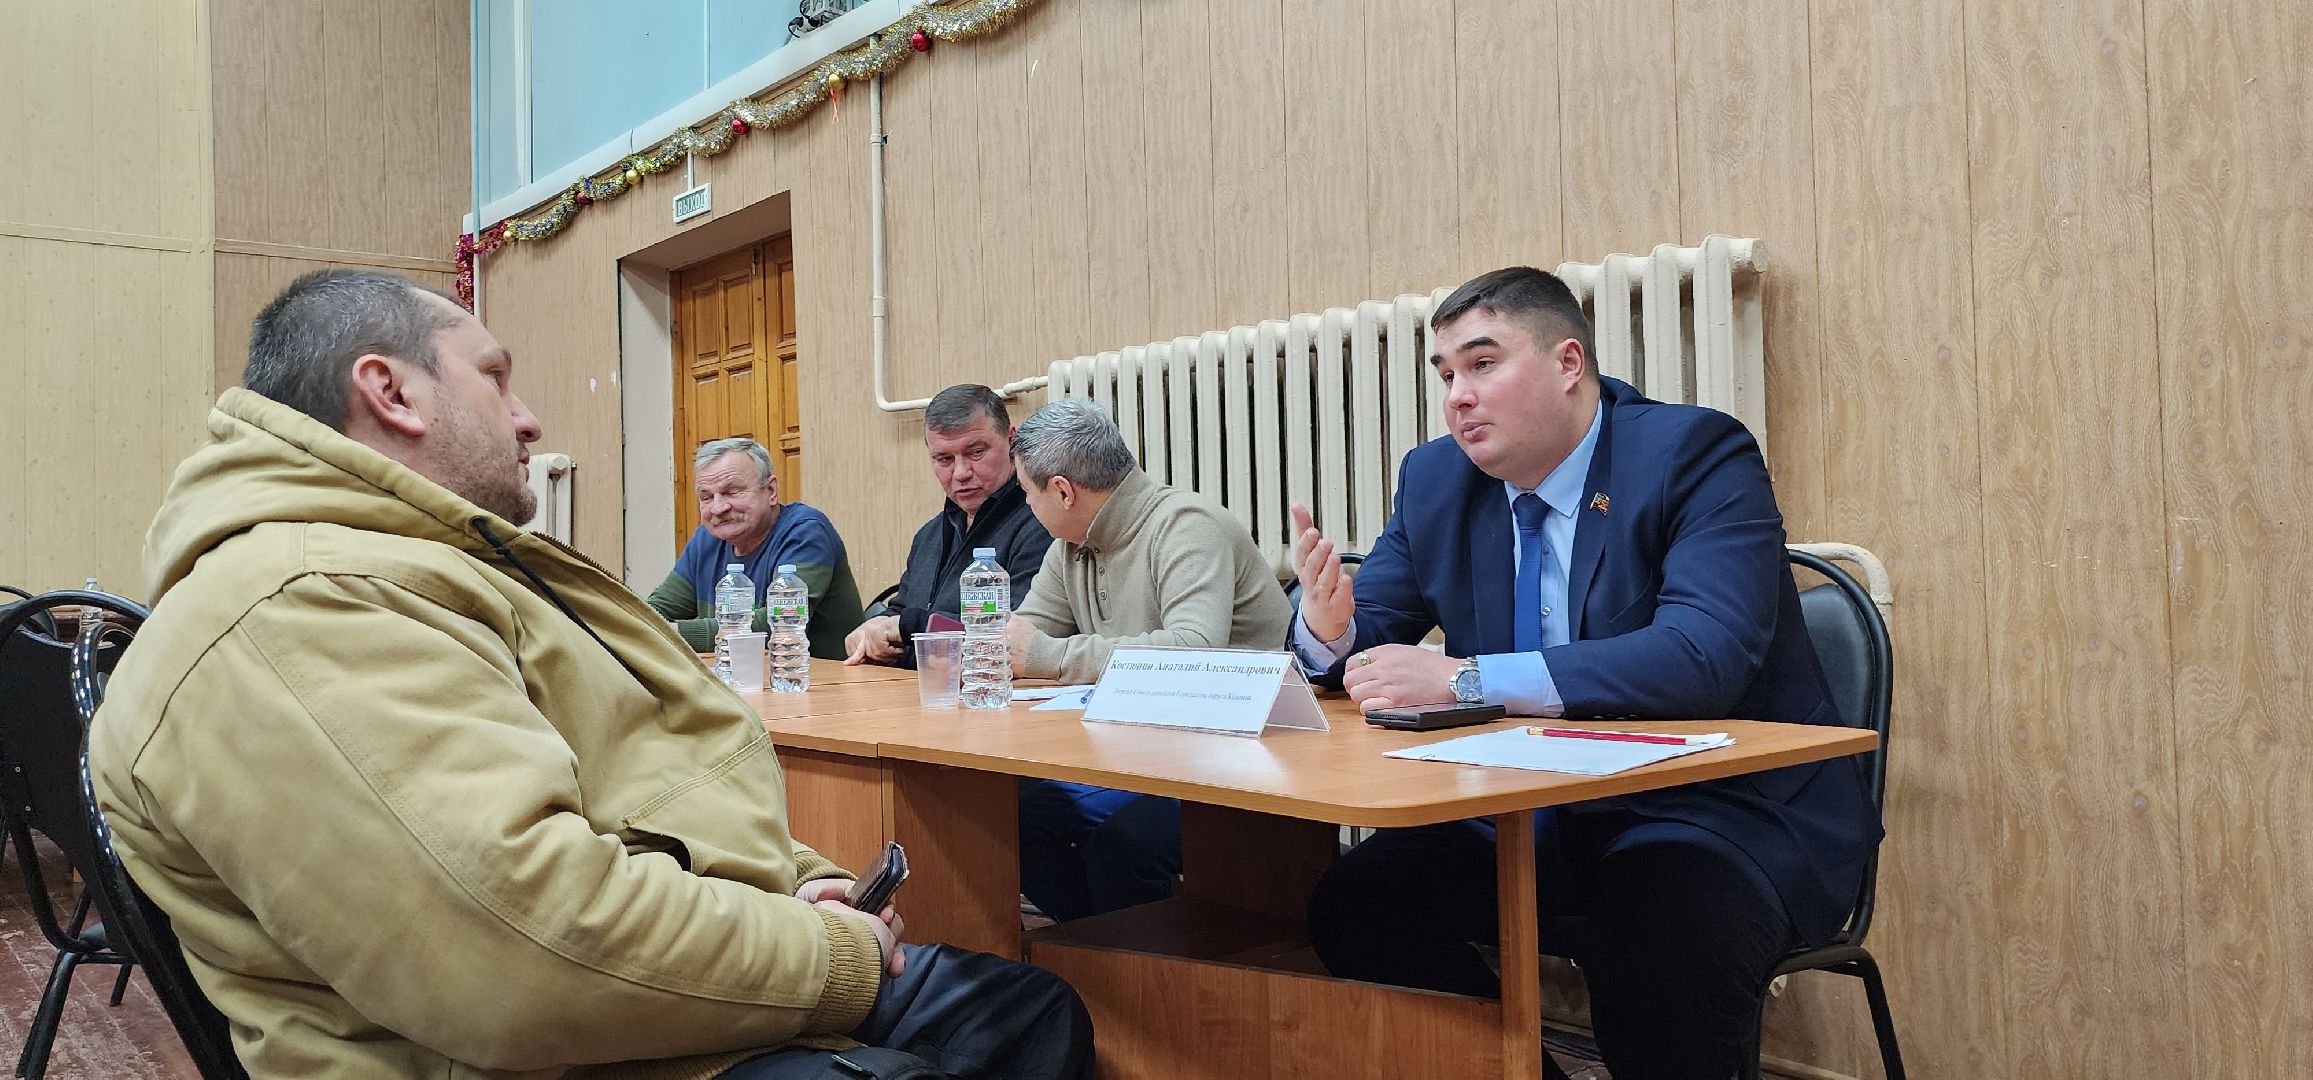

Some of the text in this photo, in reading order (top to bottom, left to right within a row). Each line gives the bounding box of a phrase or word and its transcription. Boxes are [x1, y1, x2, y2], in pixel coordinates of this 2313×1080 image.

[677, 193, 706, 217] ВЫХОД
[1155, 661, 1201, 672] Анатолий
[1201, 663, 1281, 677] Александрович
